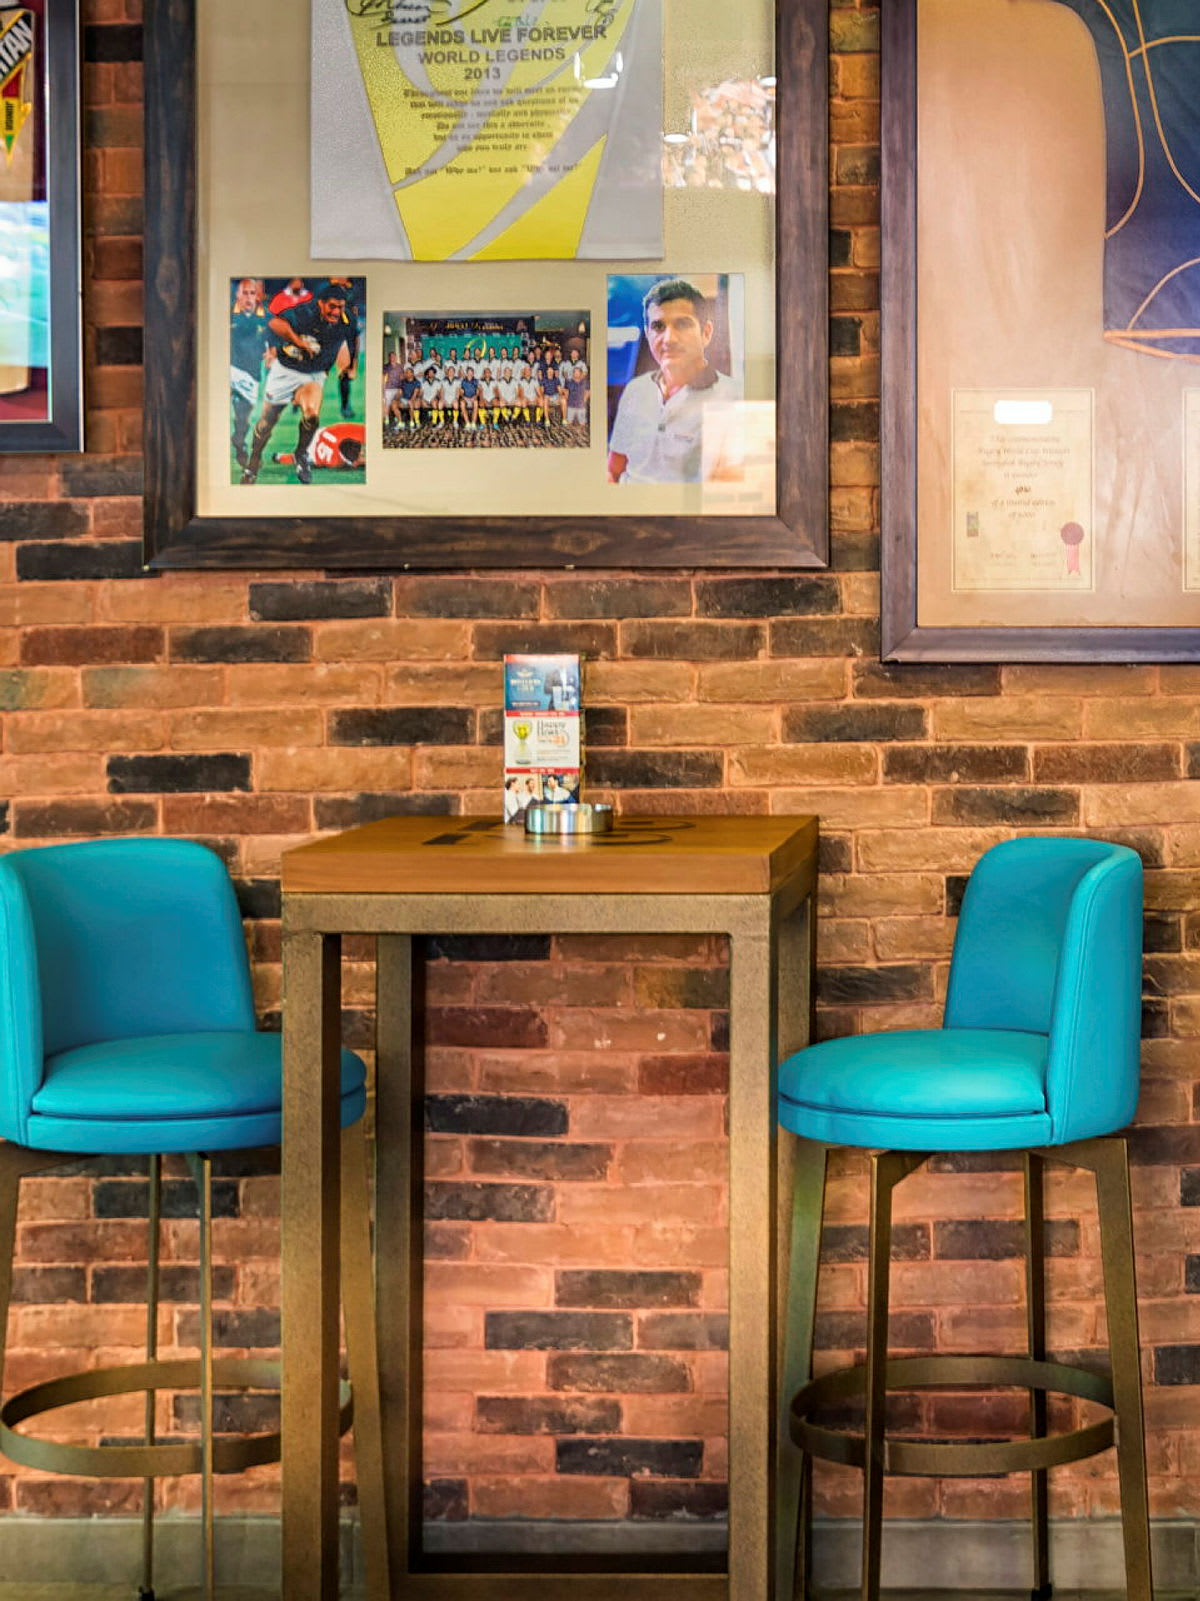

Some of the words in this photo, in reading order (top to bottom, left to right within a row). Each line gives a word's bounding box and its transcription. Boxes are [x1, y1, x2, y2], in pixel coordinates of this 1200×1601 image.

[376, 30, 466, 47] LEGENDS
[470, 27, 511, 43] LIVE
[517, 24, 607, 42] FOREVER
[0, 18, 32, 82] TAN
[419, 51, 480, 64] WORLD
[486, 48, 565, 62] LEGENDS
[464, 66, 501, 80] 2013
